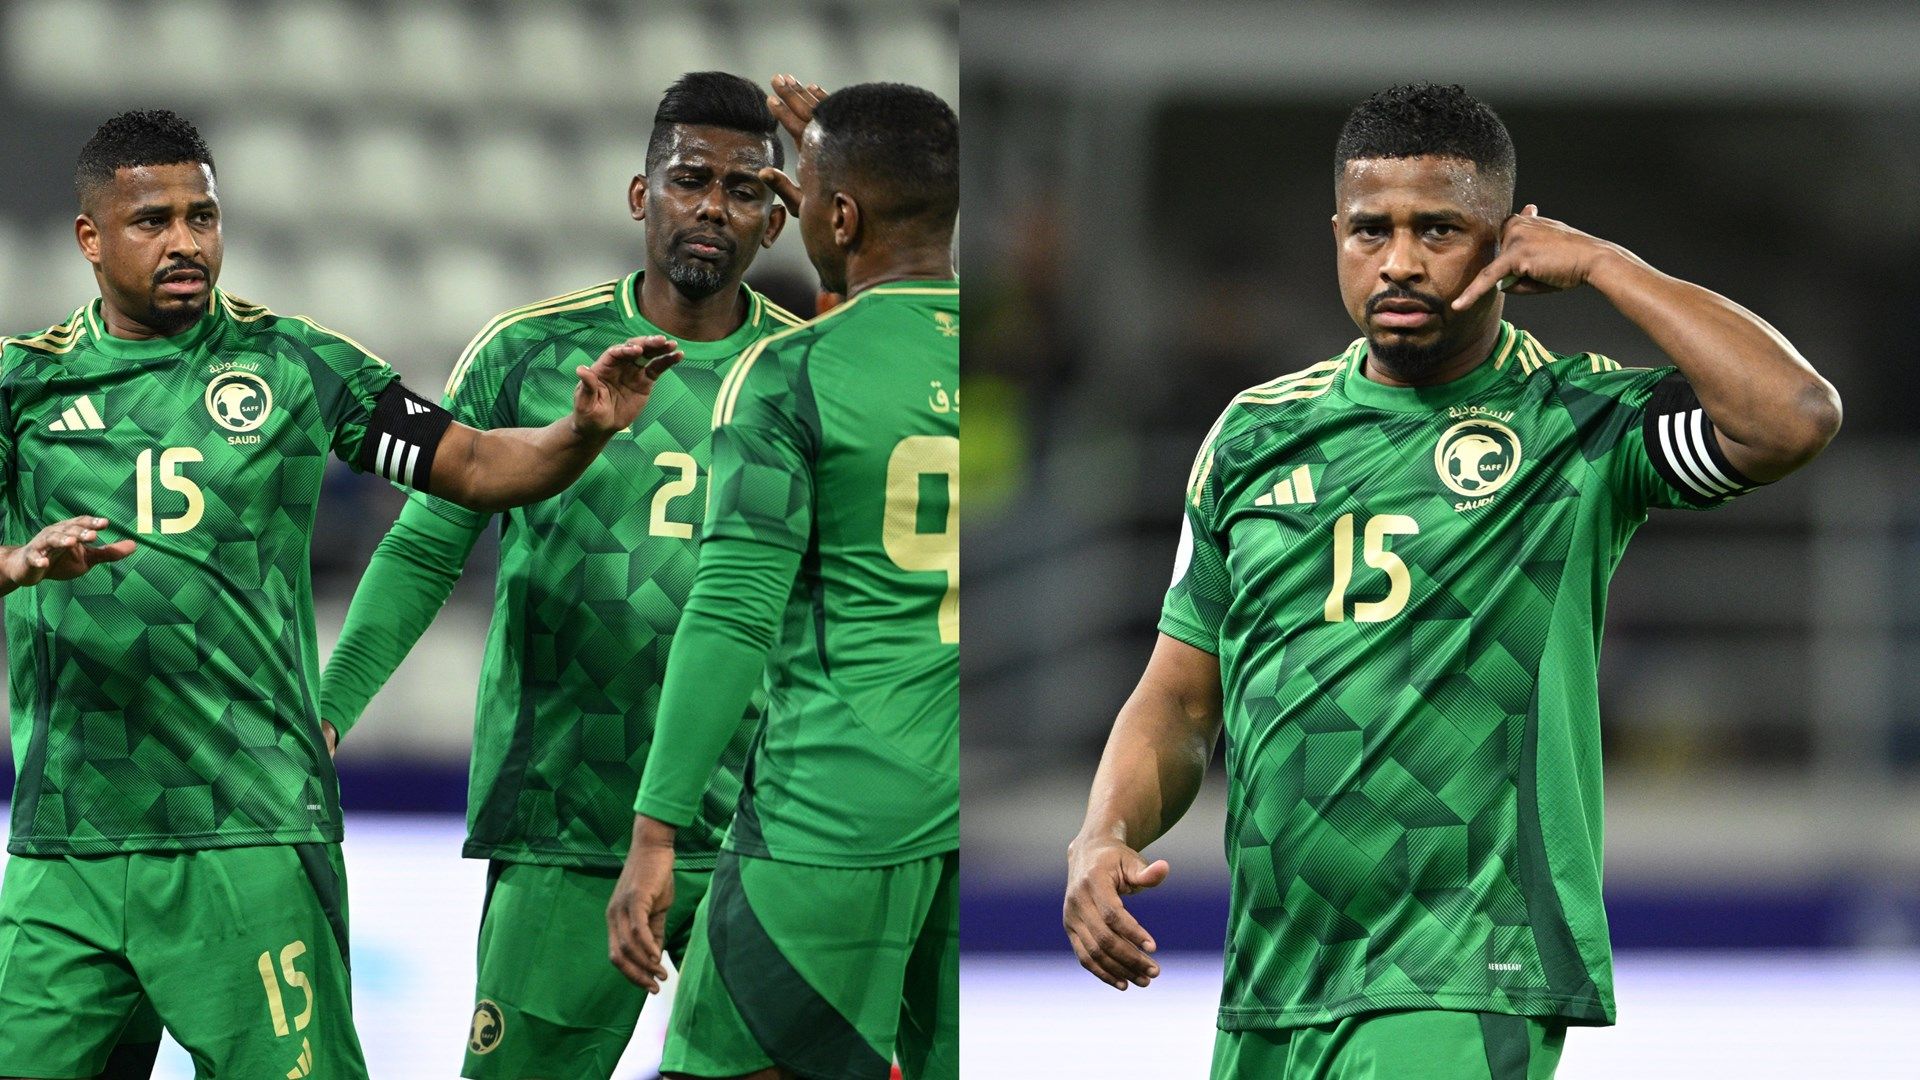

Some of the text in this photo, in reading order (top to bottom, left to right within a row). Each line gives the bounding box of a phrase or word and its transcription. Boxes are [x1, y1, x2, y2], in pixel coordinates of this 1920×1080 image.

[209, 361, 259, 373] السعودية
[227, 434, 261, 445] SAUDI
[1449, 405, 1515, 422] السعودية
[136, 447, 205, 534] 15
[649, 451, 711, 539] 2
[1454, 495, 1495, 512] SAUDI
[882, 435, 959, 644] 9
[1324, 513, 1420, 623] 15
[258, 940, 313, 1037] 15
